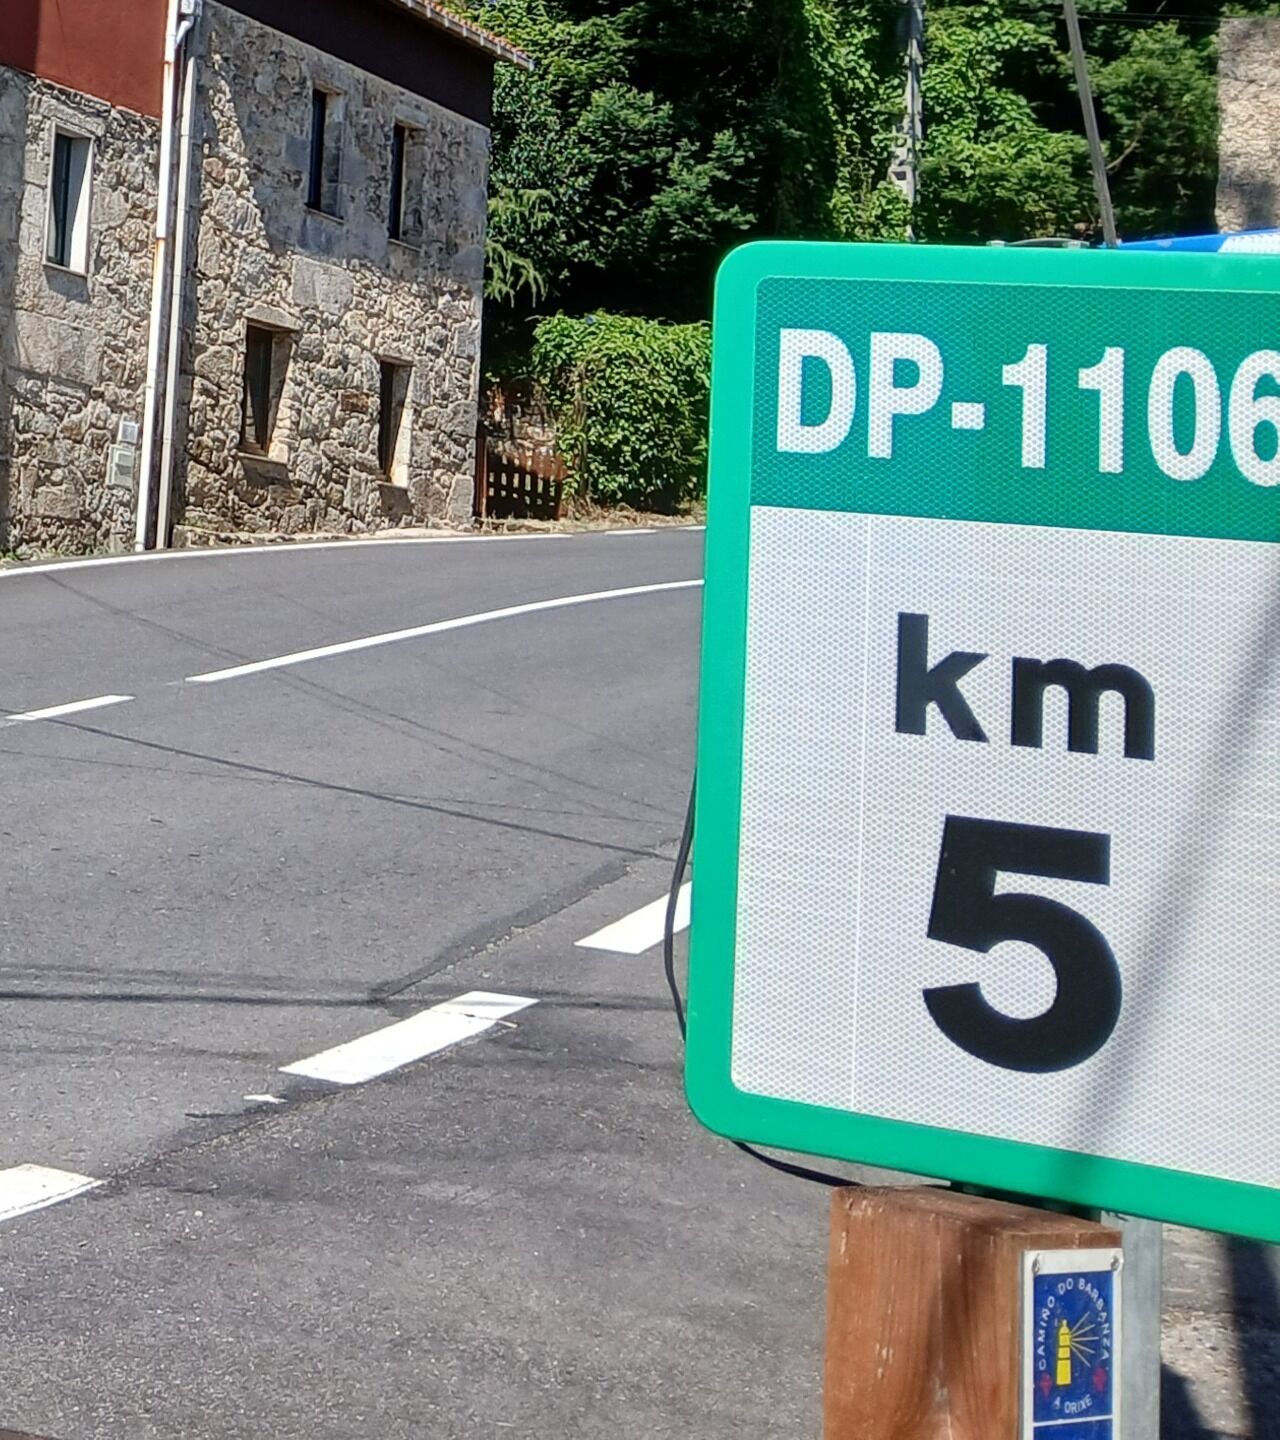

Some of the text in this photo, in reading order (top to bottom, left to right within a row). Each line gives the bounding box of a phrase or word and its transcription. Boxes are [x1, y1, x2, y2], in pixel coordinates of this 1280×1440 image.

[776, 327, 1280, 488] DP-1106
[894, 611, 1157, 762] km
[921, 813, 1123, 1075] 5
[1057, 1277, 1074, 1296] DO
[1078, 1277, 1111, 1361] BARBANZA
